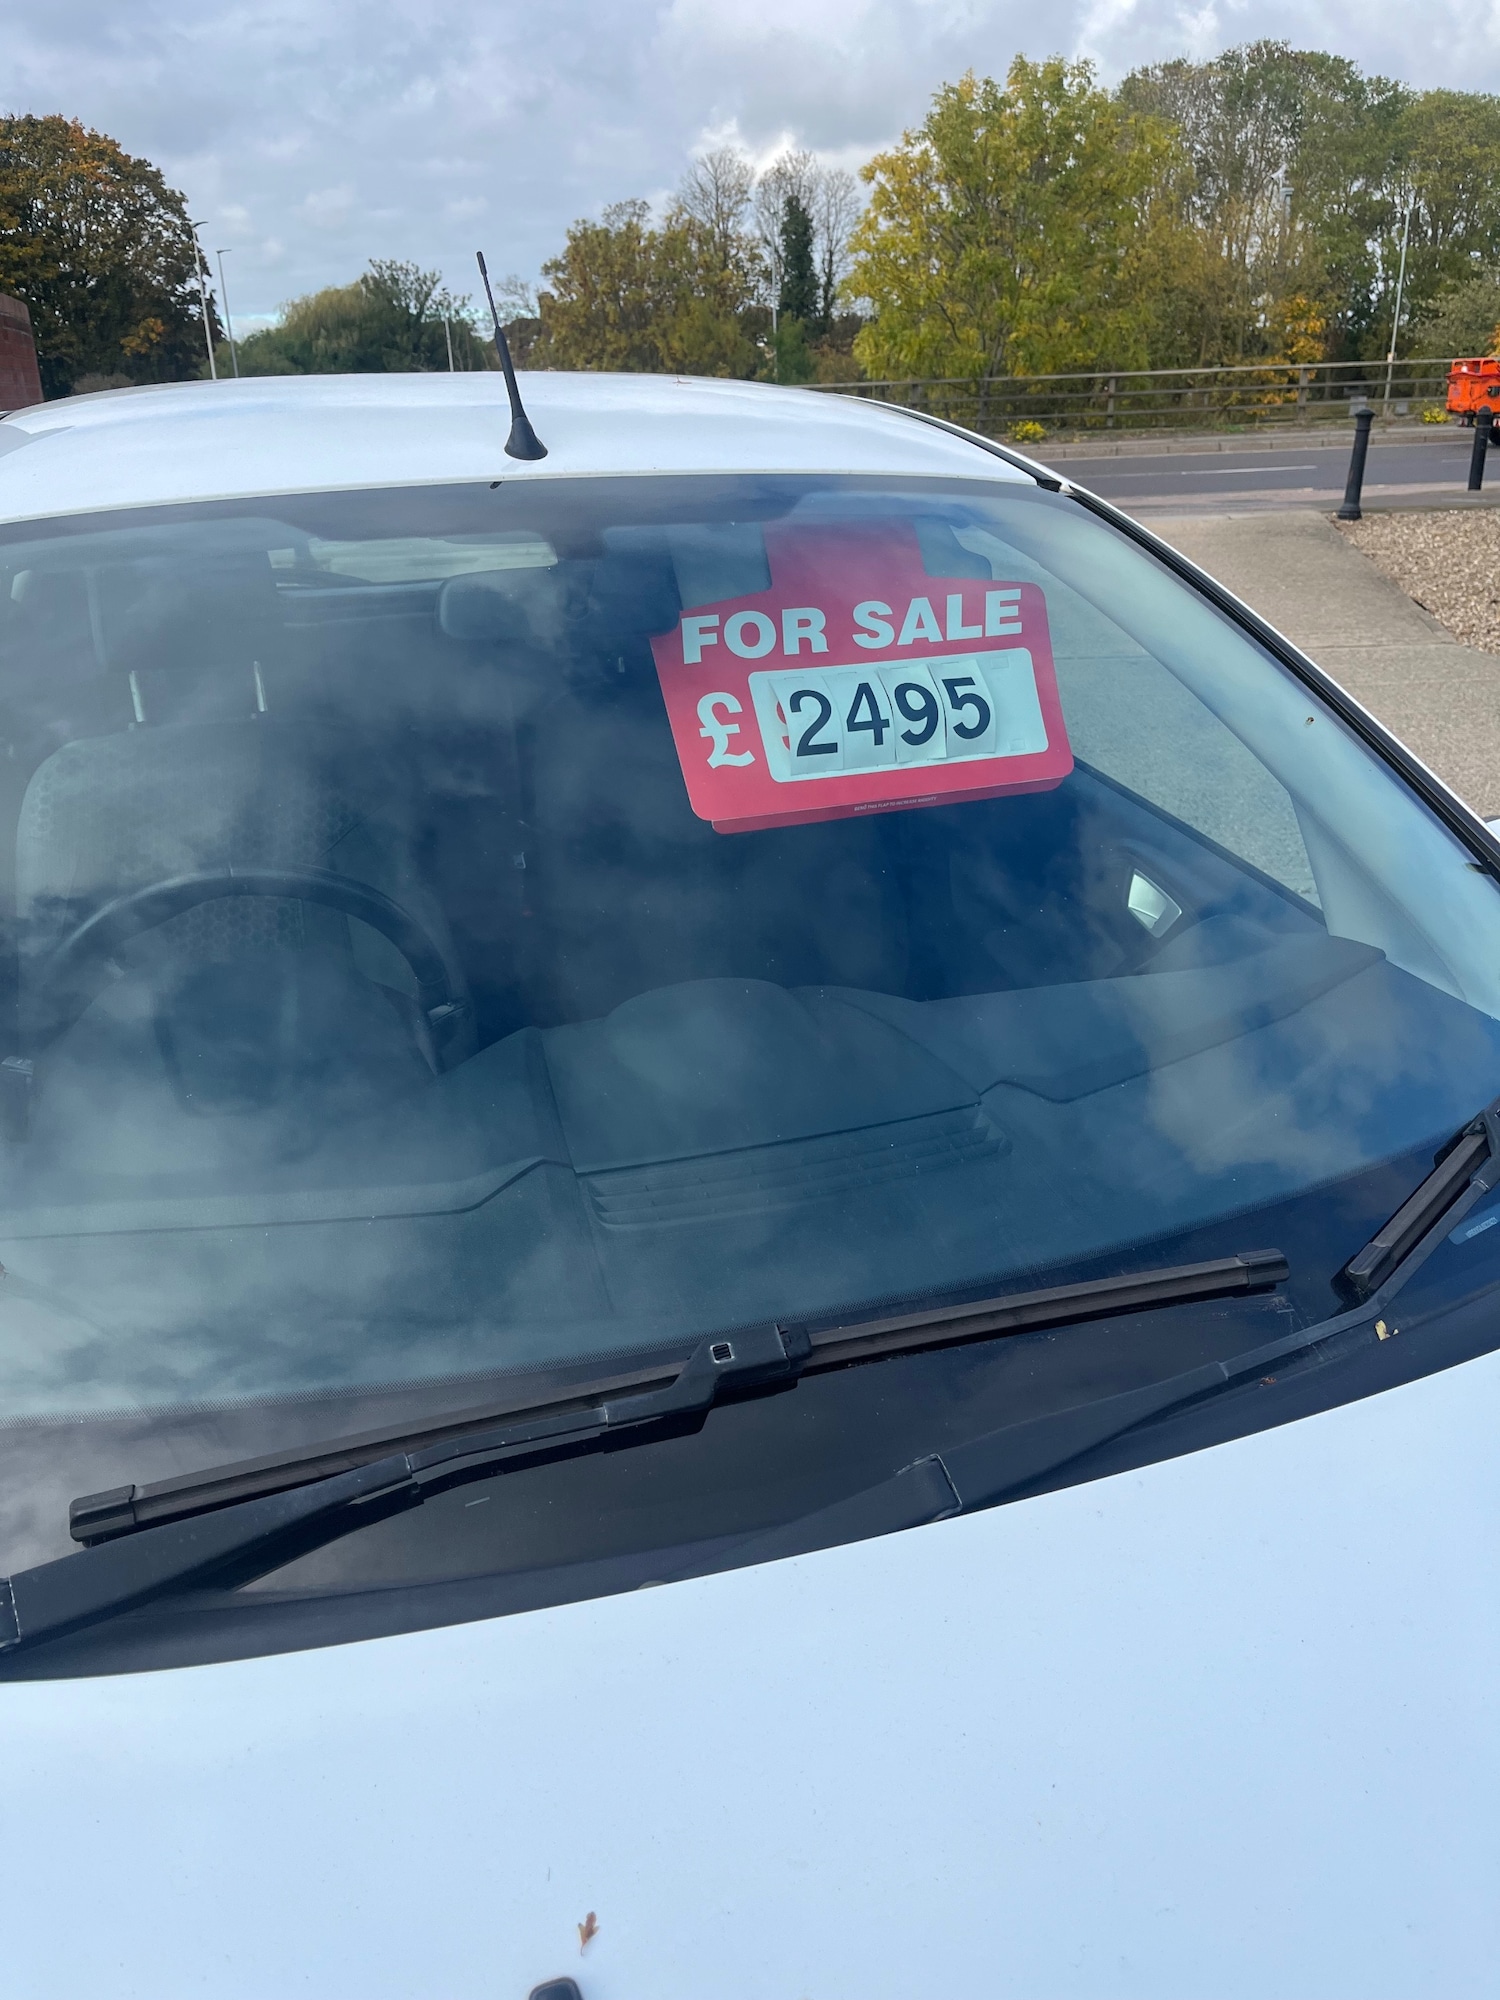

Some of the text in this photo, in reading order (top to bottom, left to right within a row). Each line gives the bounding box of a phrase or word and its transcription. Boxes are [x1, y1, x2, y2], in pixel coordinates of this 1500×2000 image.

[681, 588, 1022, 665] FOR SALE
[696, 692, 756, 769] £
[789, 676, 991, 757] 2495
